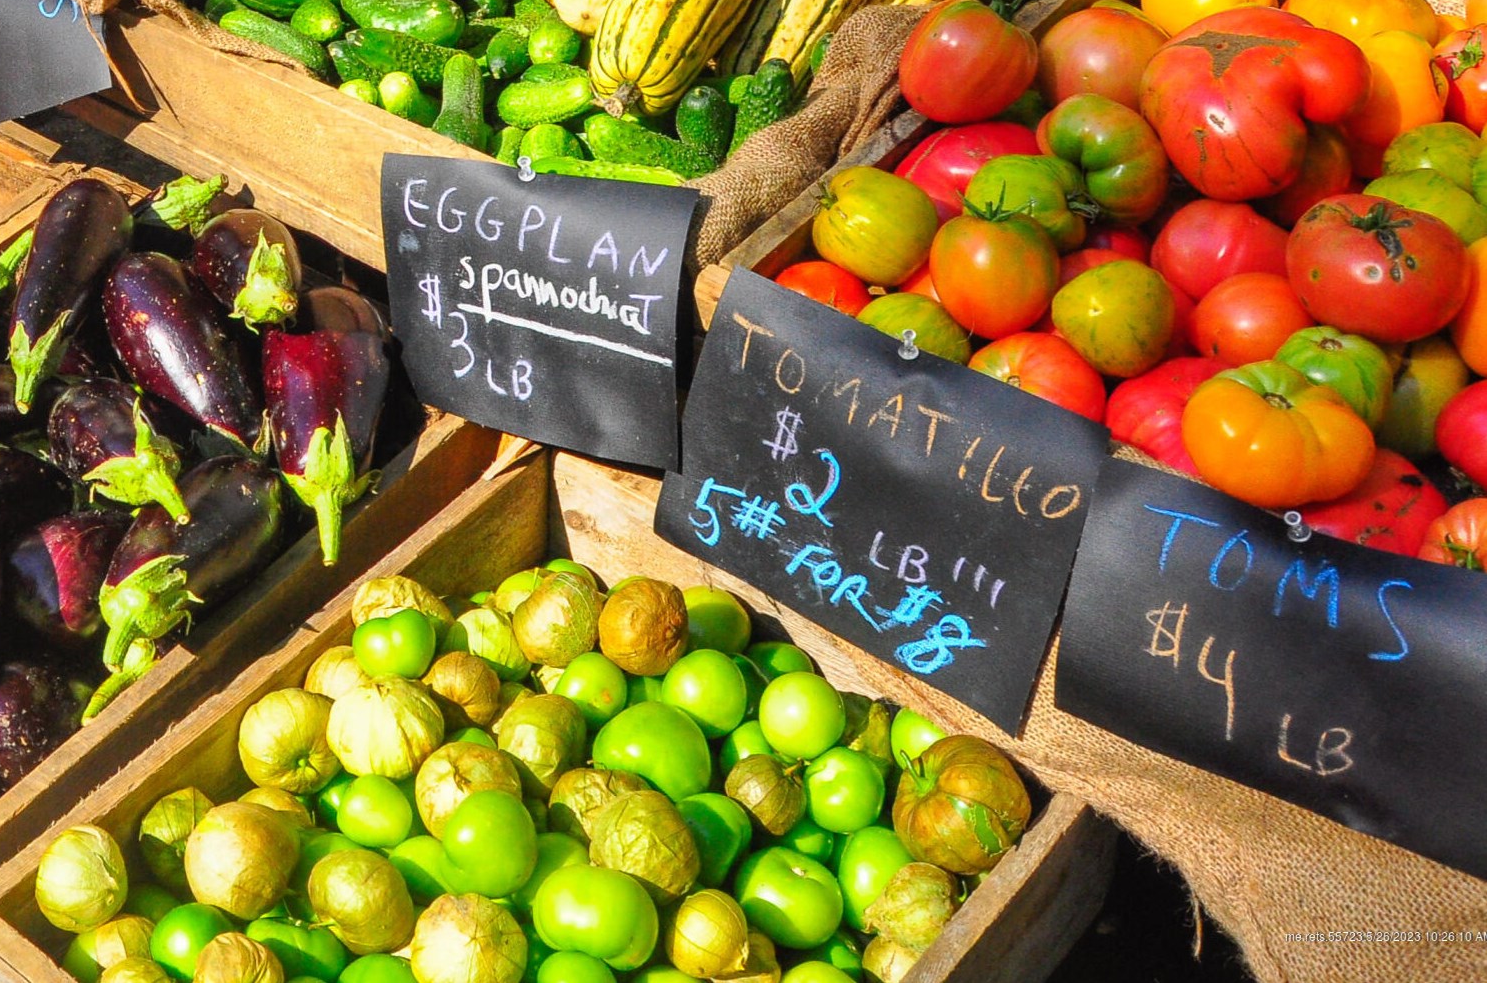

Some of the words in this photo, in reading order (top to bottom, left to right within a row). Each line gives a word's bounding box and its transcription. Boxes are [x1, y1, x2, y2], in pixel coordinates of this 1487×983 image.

[404, 179, 668, 277] EGGPLAN
[487, 359, 533, 401] LB
[733, 313, 1081, 519] TOMATILLO
[785, 544, 883, 633] FOR
[1143, 504, 1412, 662] TOMS
[1146, 601, 1235, 741] $4
[1278, 712, 1354, 777] LB
